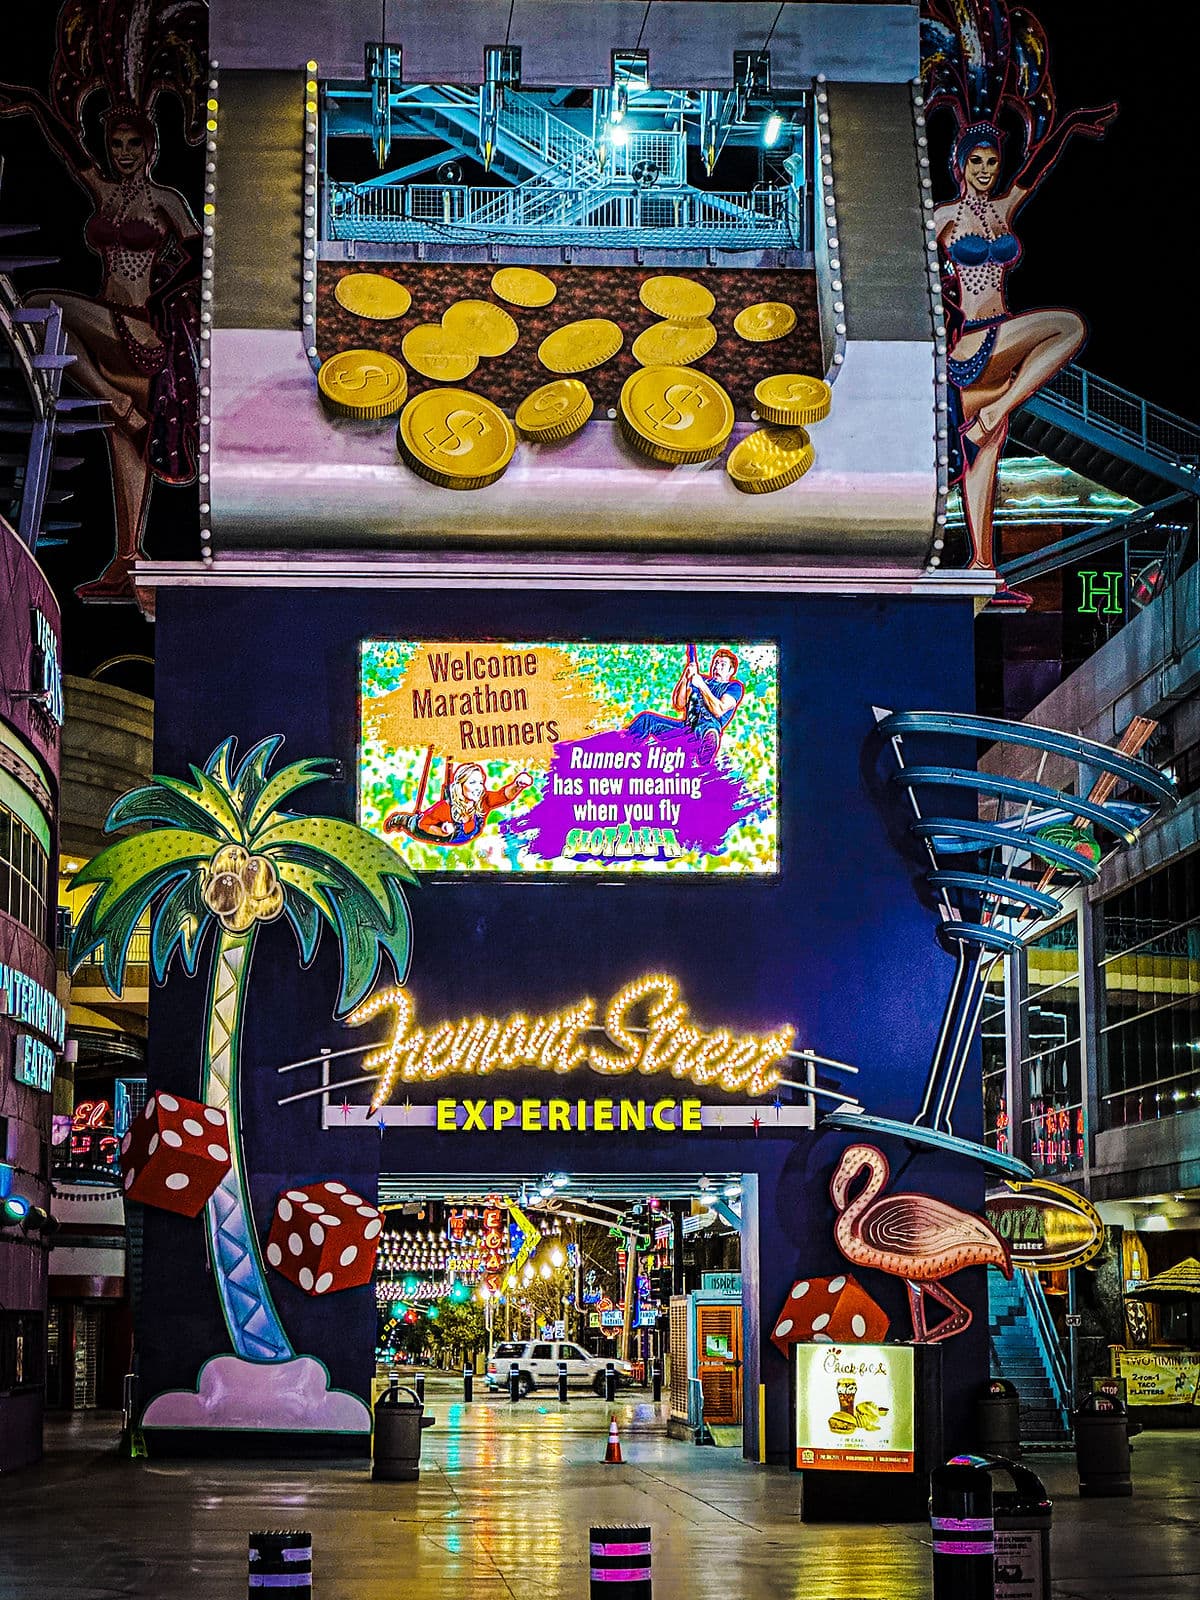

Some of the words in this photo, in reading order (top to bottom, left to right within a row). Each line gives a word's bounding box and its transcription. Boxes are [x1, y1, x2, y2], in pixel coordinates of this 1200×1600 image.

[1078, 571, 1122, 613] H
[427, 649, 538, 681] Welcome
[411, 684, 529, 719] Marathon
[459, 718, 560, 751] Runners
[570, 747, 642, 770] Runners
[646, 747, 686, 770] High
[553, 775, 584, 796] has
[589, 779, 622, 796] new
[629, 775, 701, 800] meaning
[573, 800, 619, 822] when
[624, 804, 654, 824] you
[658, 800, 681, 824] fly
[346, 984, 594, 1117] Fremont
[588, 971, 797, 1098] Street
[436, 1098, 702, 1131] EXPERIENCE
[1013, 1242, 1044, 1250] enter
